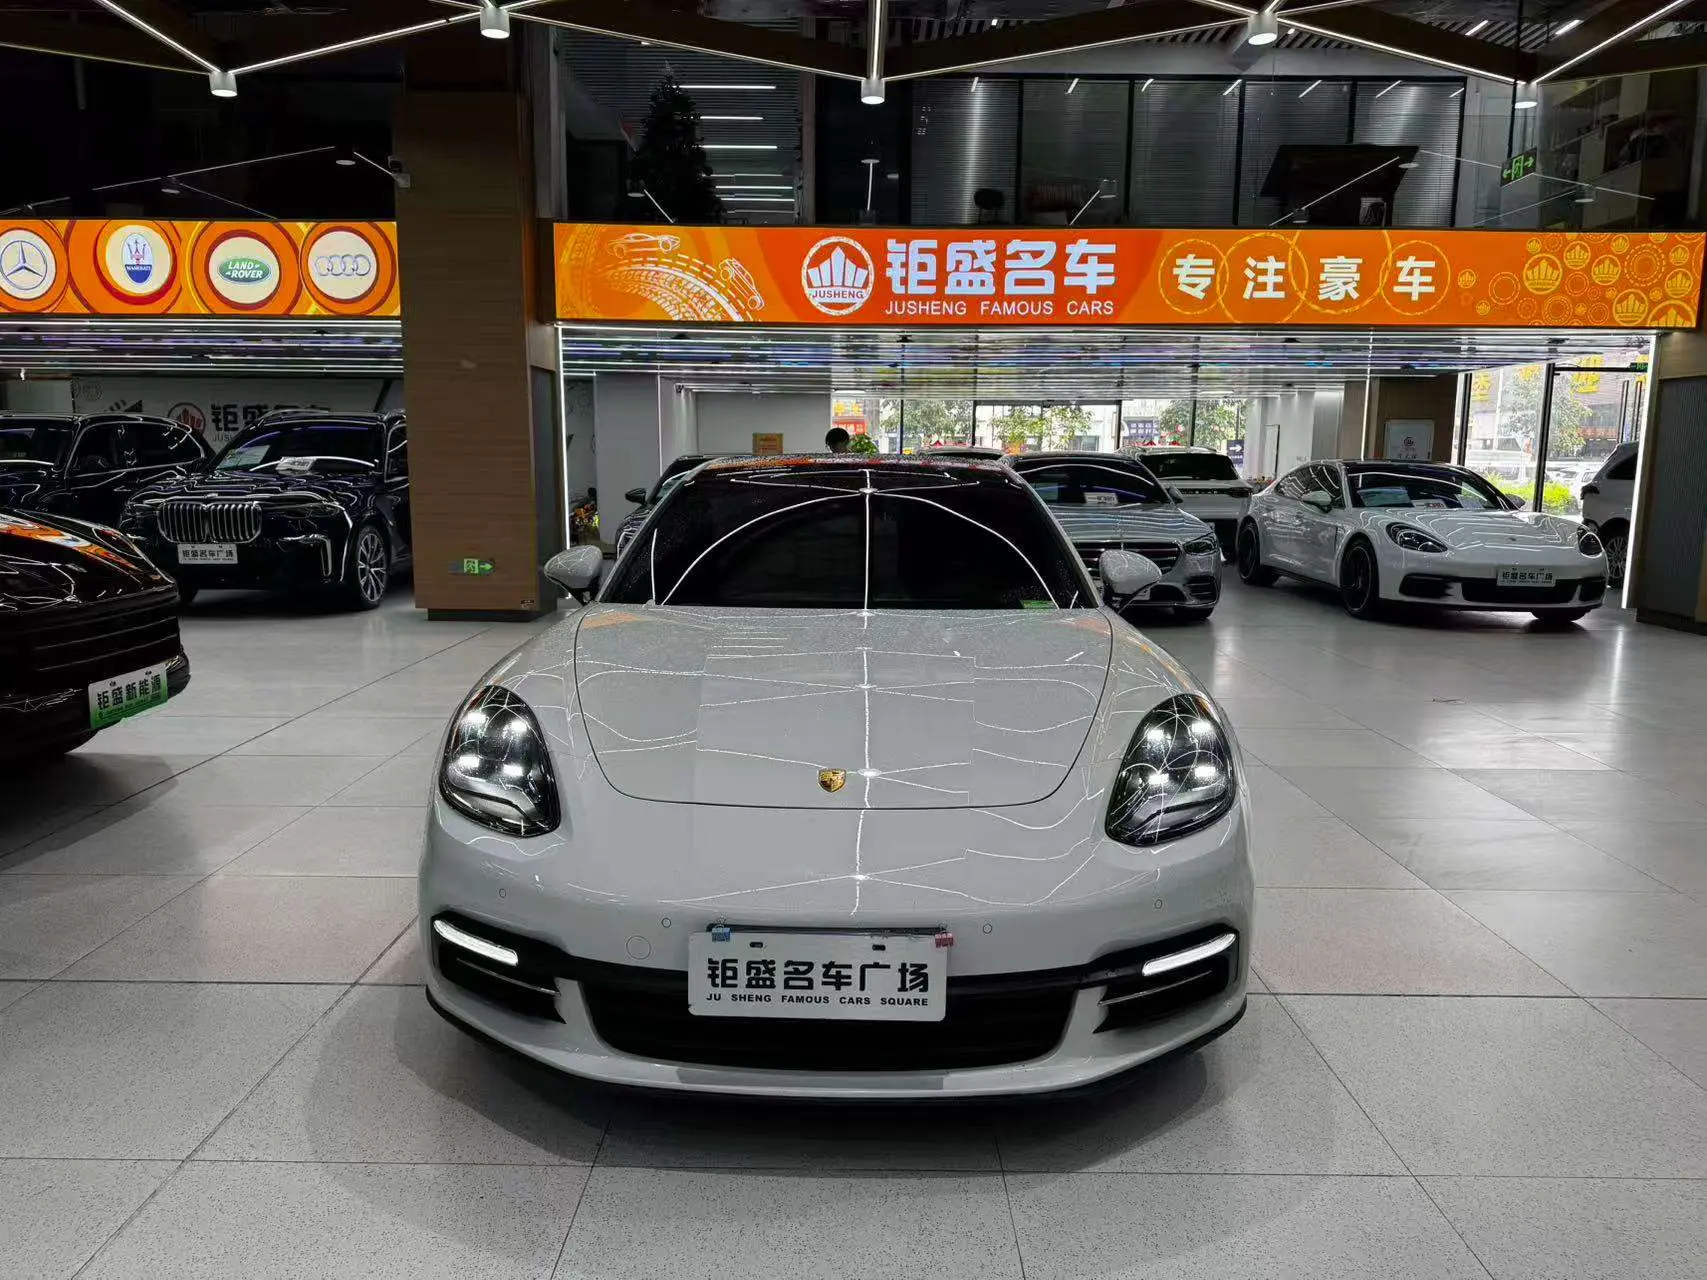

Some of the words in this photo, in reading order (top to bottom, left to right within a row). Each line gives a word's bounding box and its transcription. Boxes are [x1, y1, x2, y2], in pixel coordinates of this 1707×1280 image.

[228, 260, 254, 270] LAND
[886, 239, 1117, 296] 钜盛名车
[231, 270, 263, 279] ROVER
[1172, 254, 1437, 302] 专注豪车
[812, 289, 865, 300] JUSHENG
[884, 300, 968, 317] JUSHENG
[980, 300, 1054, 317] FAMOUS
[1066, 300, 1116, 317] CARS
[97, 674, 161, 710] 钜盛新能源
[707, 957, 929, 992] 钜盛名车广场
[706, 993, 722, 1002] JU
[731, 993, 772, 1003] SHENG
[781, 995, 830, 1005] FAMOUS
[839, 996, 871, 1005] CARS
[880, 997, 929, 1006] SQUARE
